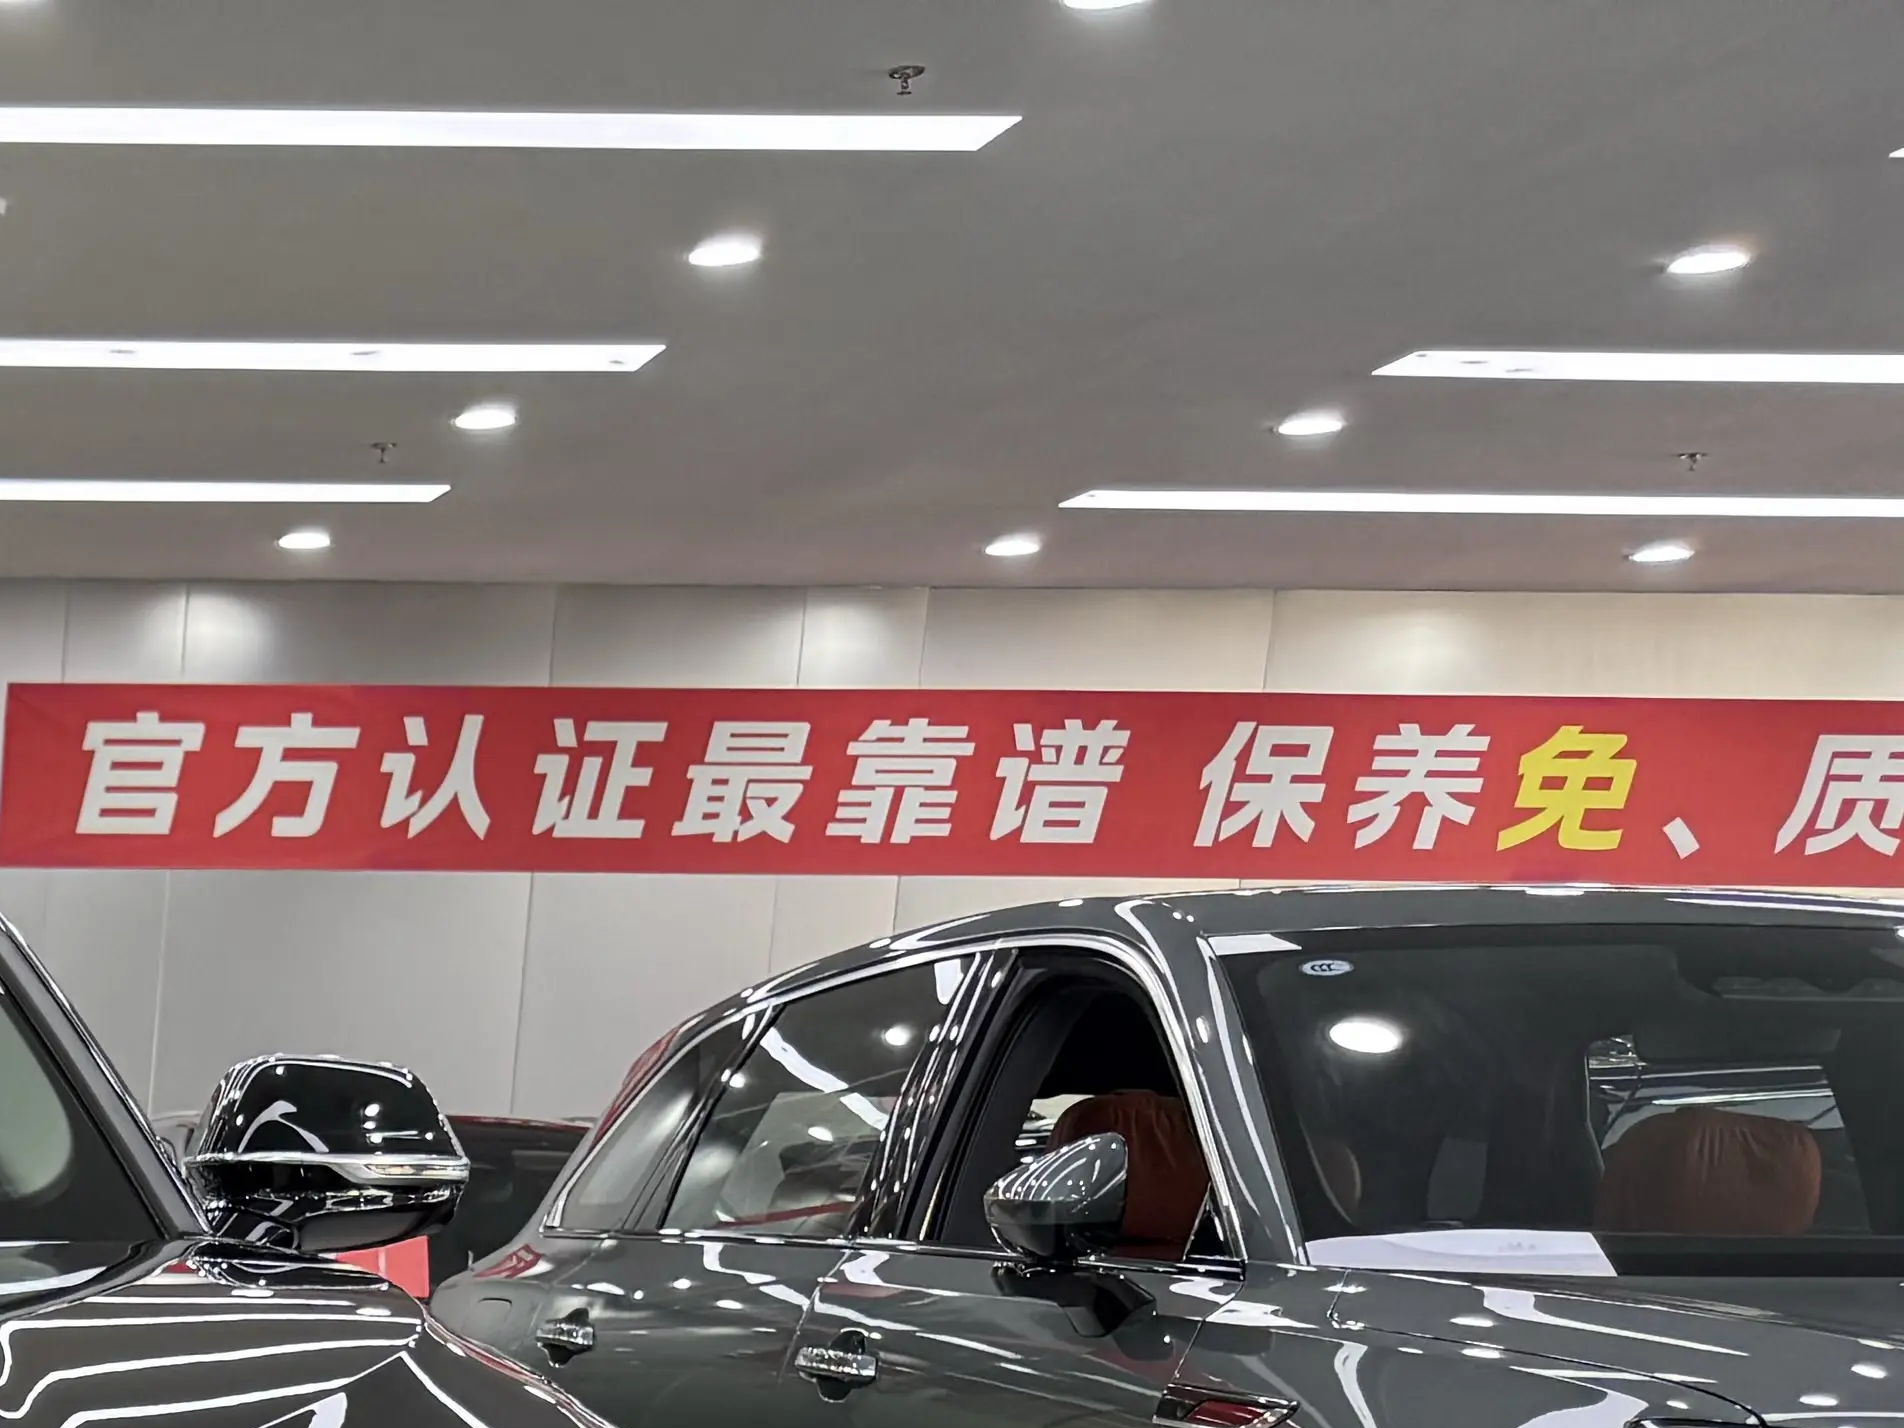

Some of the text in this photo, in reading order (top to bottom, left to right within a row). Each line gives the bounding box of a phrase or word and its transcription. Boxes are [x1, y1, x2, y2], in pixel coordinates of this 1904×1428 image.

[74, 711, 1132, 846] 官方认证最靠谱
